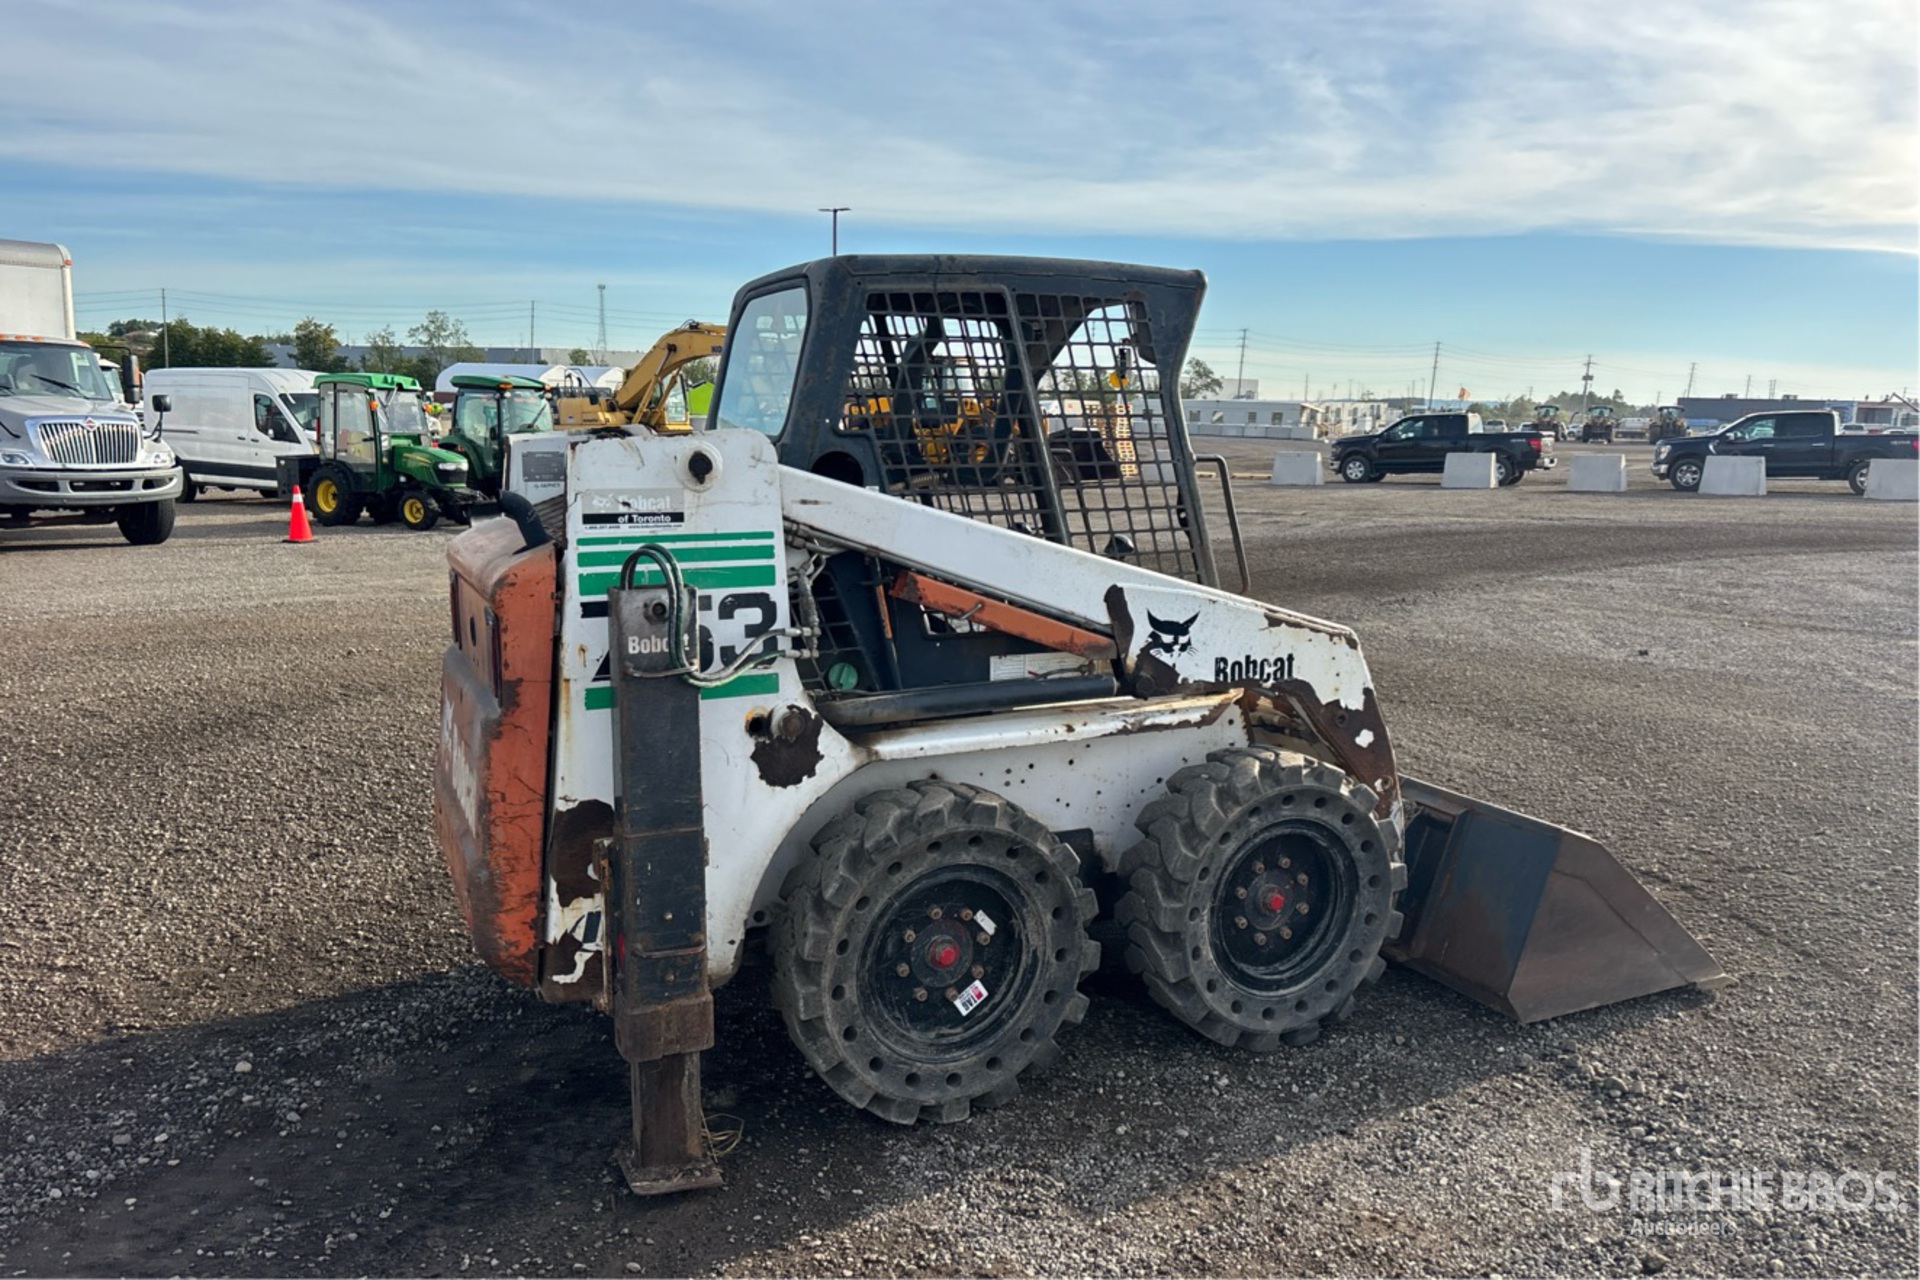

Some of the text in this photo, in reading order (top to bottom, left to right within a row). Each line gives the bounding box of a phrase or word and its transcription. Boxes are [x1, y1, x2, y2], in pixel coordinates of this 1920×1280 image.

[617, 495, 670, 512] Bobcat
[618, 514, 671, 524] of Toronto
[628, 635, 690, 654] Bobct
[1214, 653, 1295, 684] Bobcat
